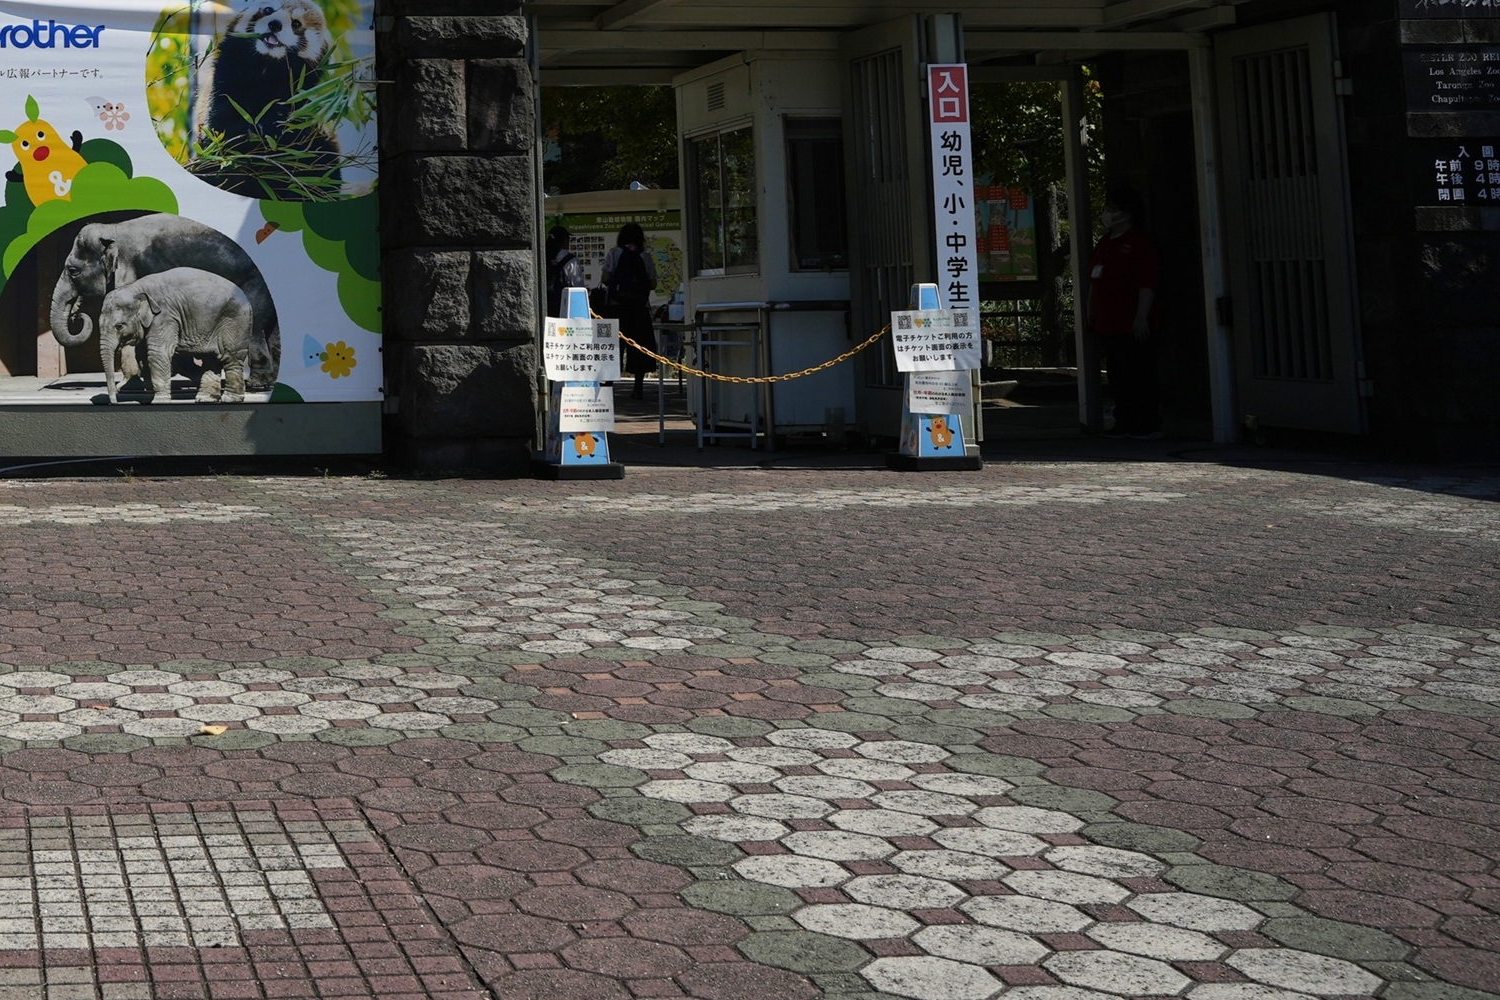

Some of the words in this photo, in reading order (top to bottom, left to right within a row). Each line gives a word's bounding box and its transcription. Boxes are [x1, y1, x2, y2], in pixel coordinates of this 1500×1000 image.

[1421, 53, 1455, 62] SSTER
[1429, 67, 1444, 76] Los
[1449, 67, 1482, 76] Angeles
[937, 72, 960, 118] 入口
[1431, 94, 1482, 105] Chapult
[1434, 159, 1462, 172] 午前
[1436, 172, 1464, 185] 午後
[1437, 188, 1465, 201] 閉園
[940, 131, 970, 309] 幼児、小・中学生
[896, 332, 973, 342] 電子チケットご利用の方
[897, 343, 974, 352] はチケット画面の表示を
[912, 354, 957, 362] お願いします。
